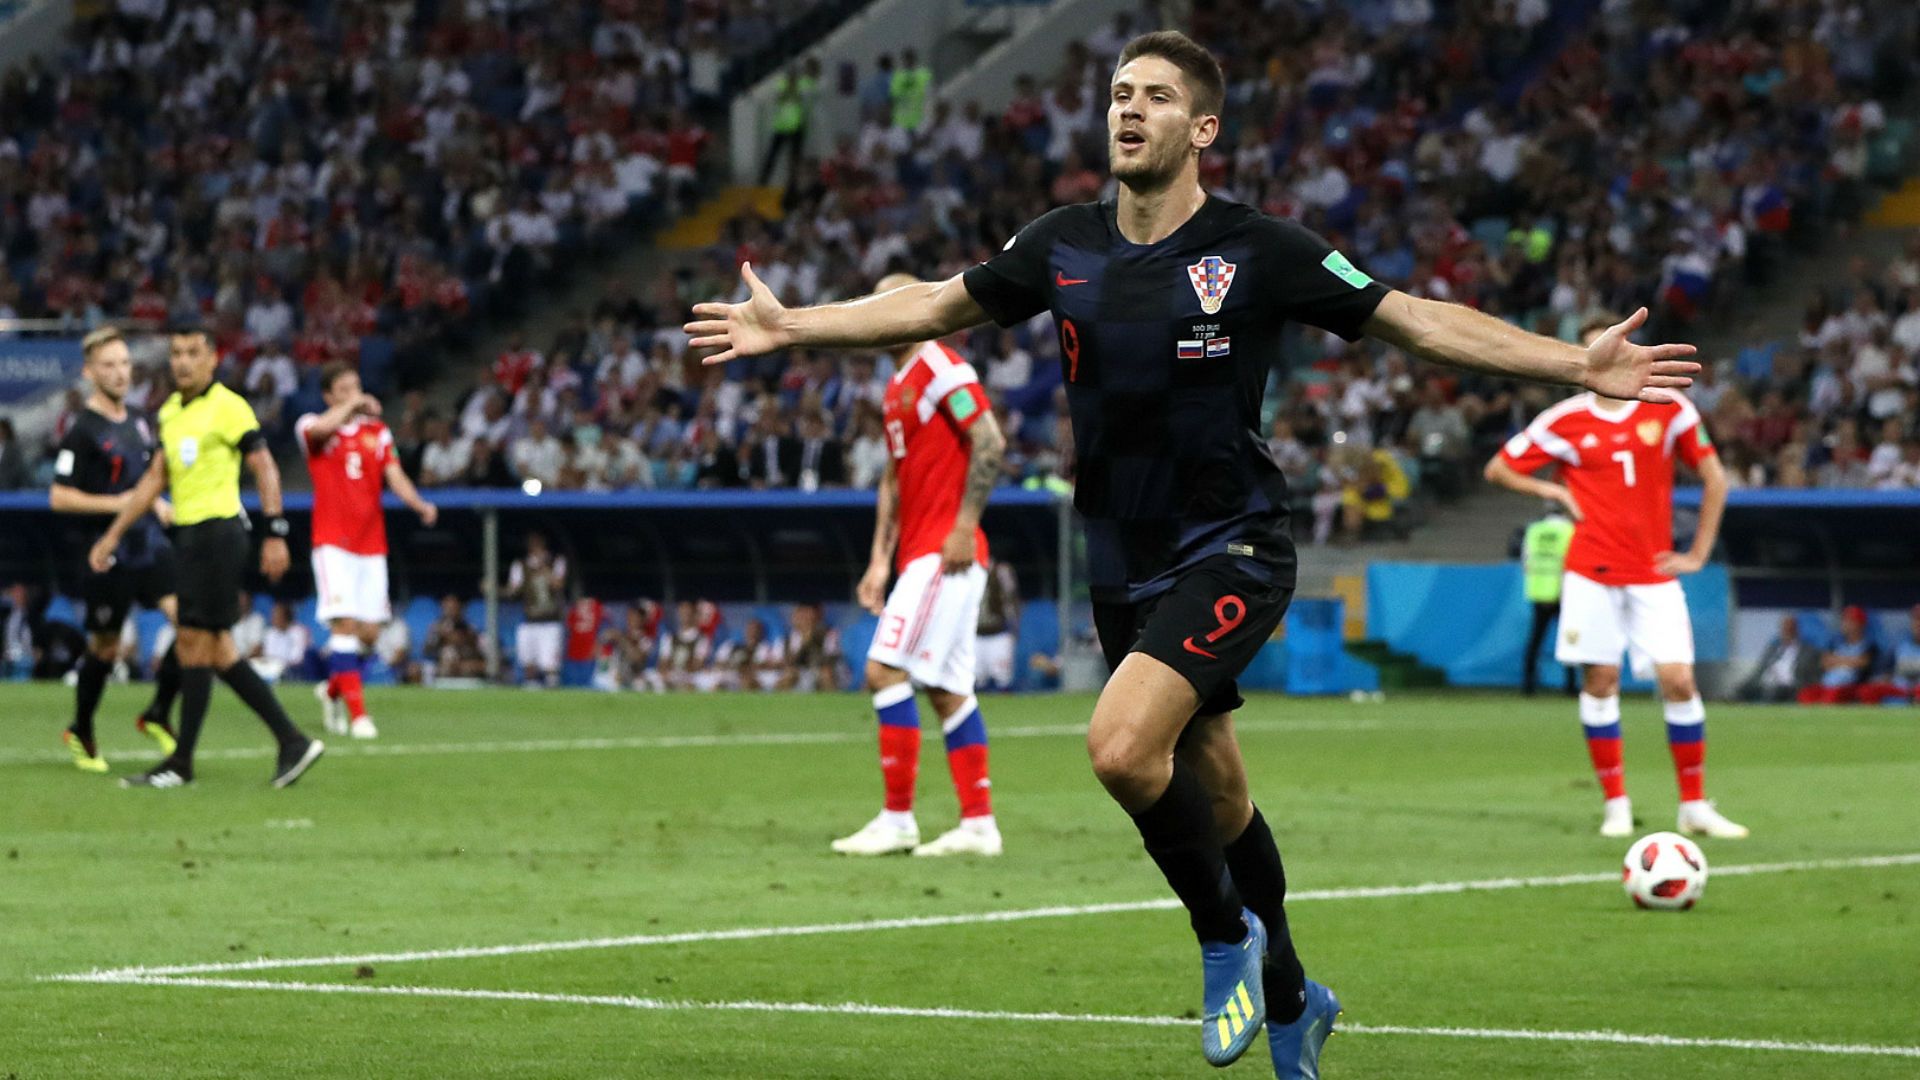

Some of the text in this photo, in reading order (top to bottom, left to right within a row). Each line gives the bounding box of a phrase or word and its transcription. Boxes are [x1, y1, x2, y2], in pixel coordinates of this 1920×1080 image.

[1061, 319, 1080, 383] 9
[1611, 450, 1636, 488] 7
[1205, 594, 1247, 643] 9
